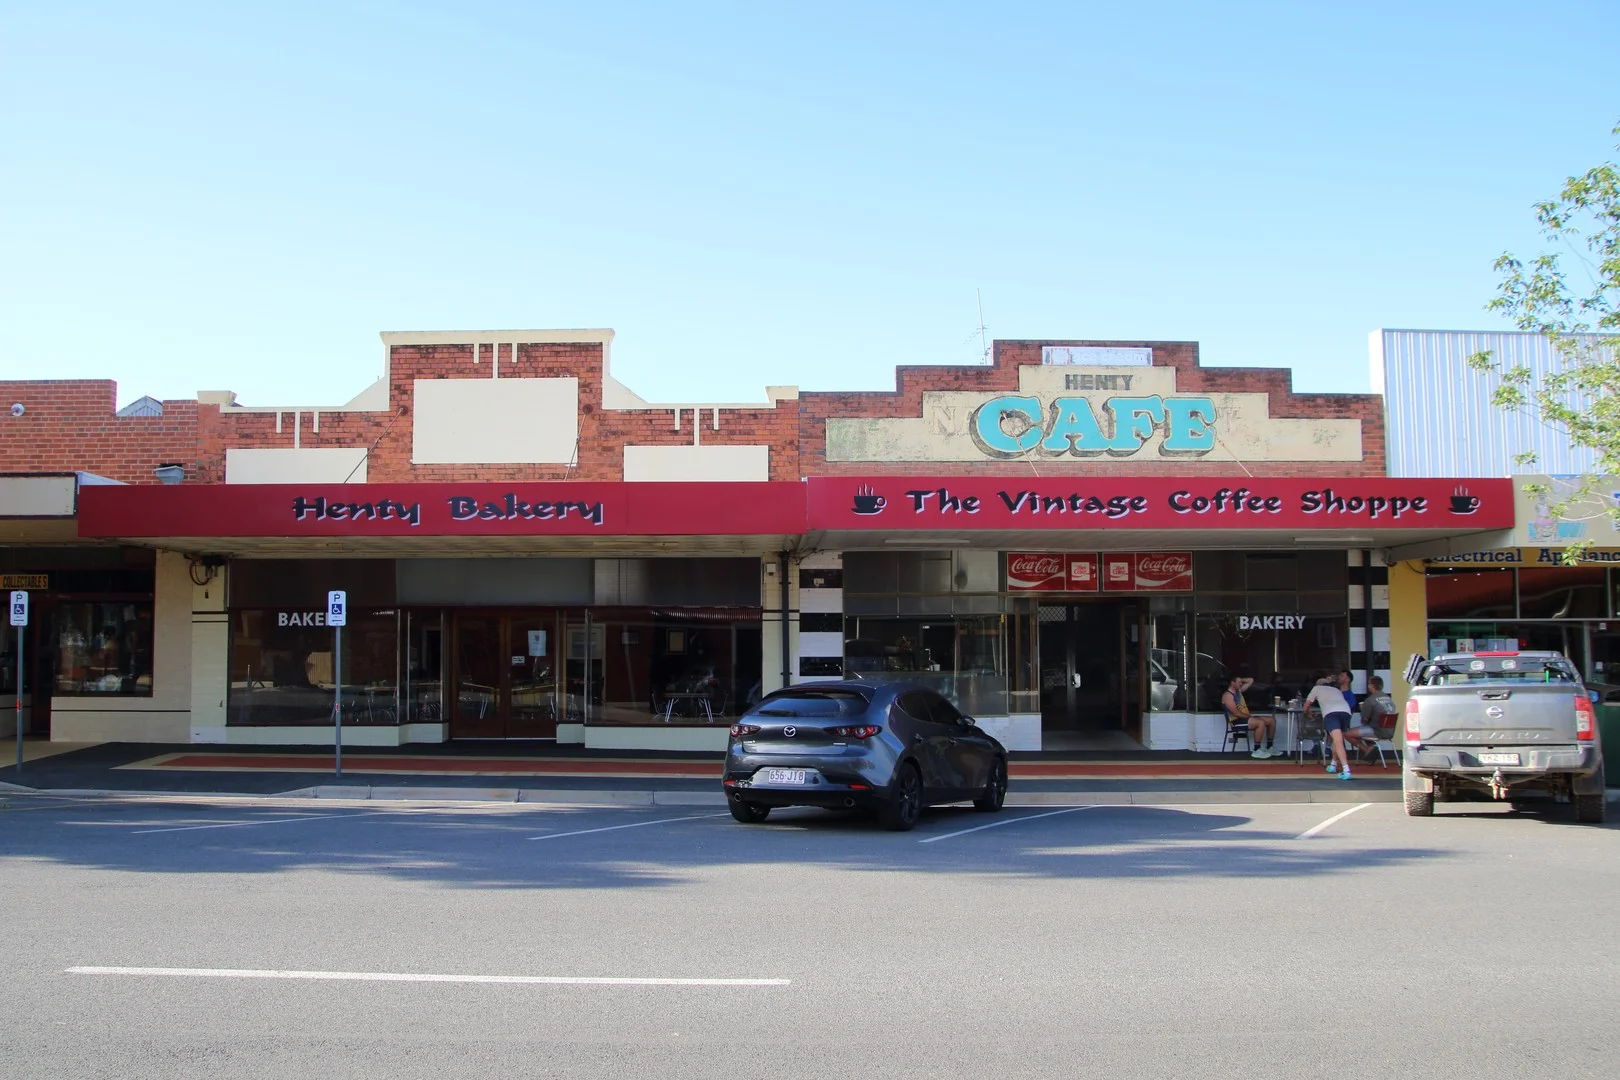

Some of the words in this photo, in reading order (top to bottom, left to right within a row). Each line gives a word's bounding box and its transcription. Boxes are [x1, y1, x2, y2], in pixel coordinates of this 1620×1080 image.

[1065, 374, 1133, 390] HENTY
[969, 395, 1217, 458] CAFE
[292, 496, 421, 526] Henty
[448, 492, 604, 526] Bakery
[904, 488, 981, 514] The
[997, 491, 1148, 519] Vintage
[1168, 488, 1282, 514] Coffee
[1300, 488, 1428, 519] Shoppe
[1537, 548, 1620, 565] Apianc
[1011, 557, 1061, 573] Coca-Cola
[1138, 557, 1187, 573] Coca-Cola
[16, 594, 23, 602] P
[334, 593, 341, 602] P
[278, 612, 328, 626] BAKE
[1240, 615, 1306, 629] BAKERY
